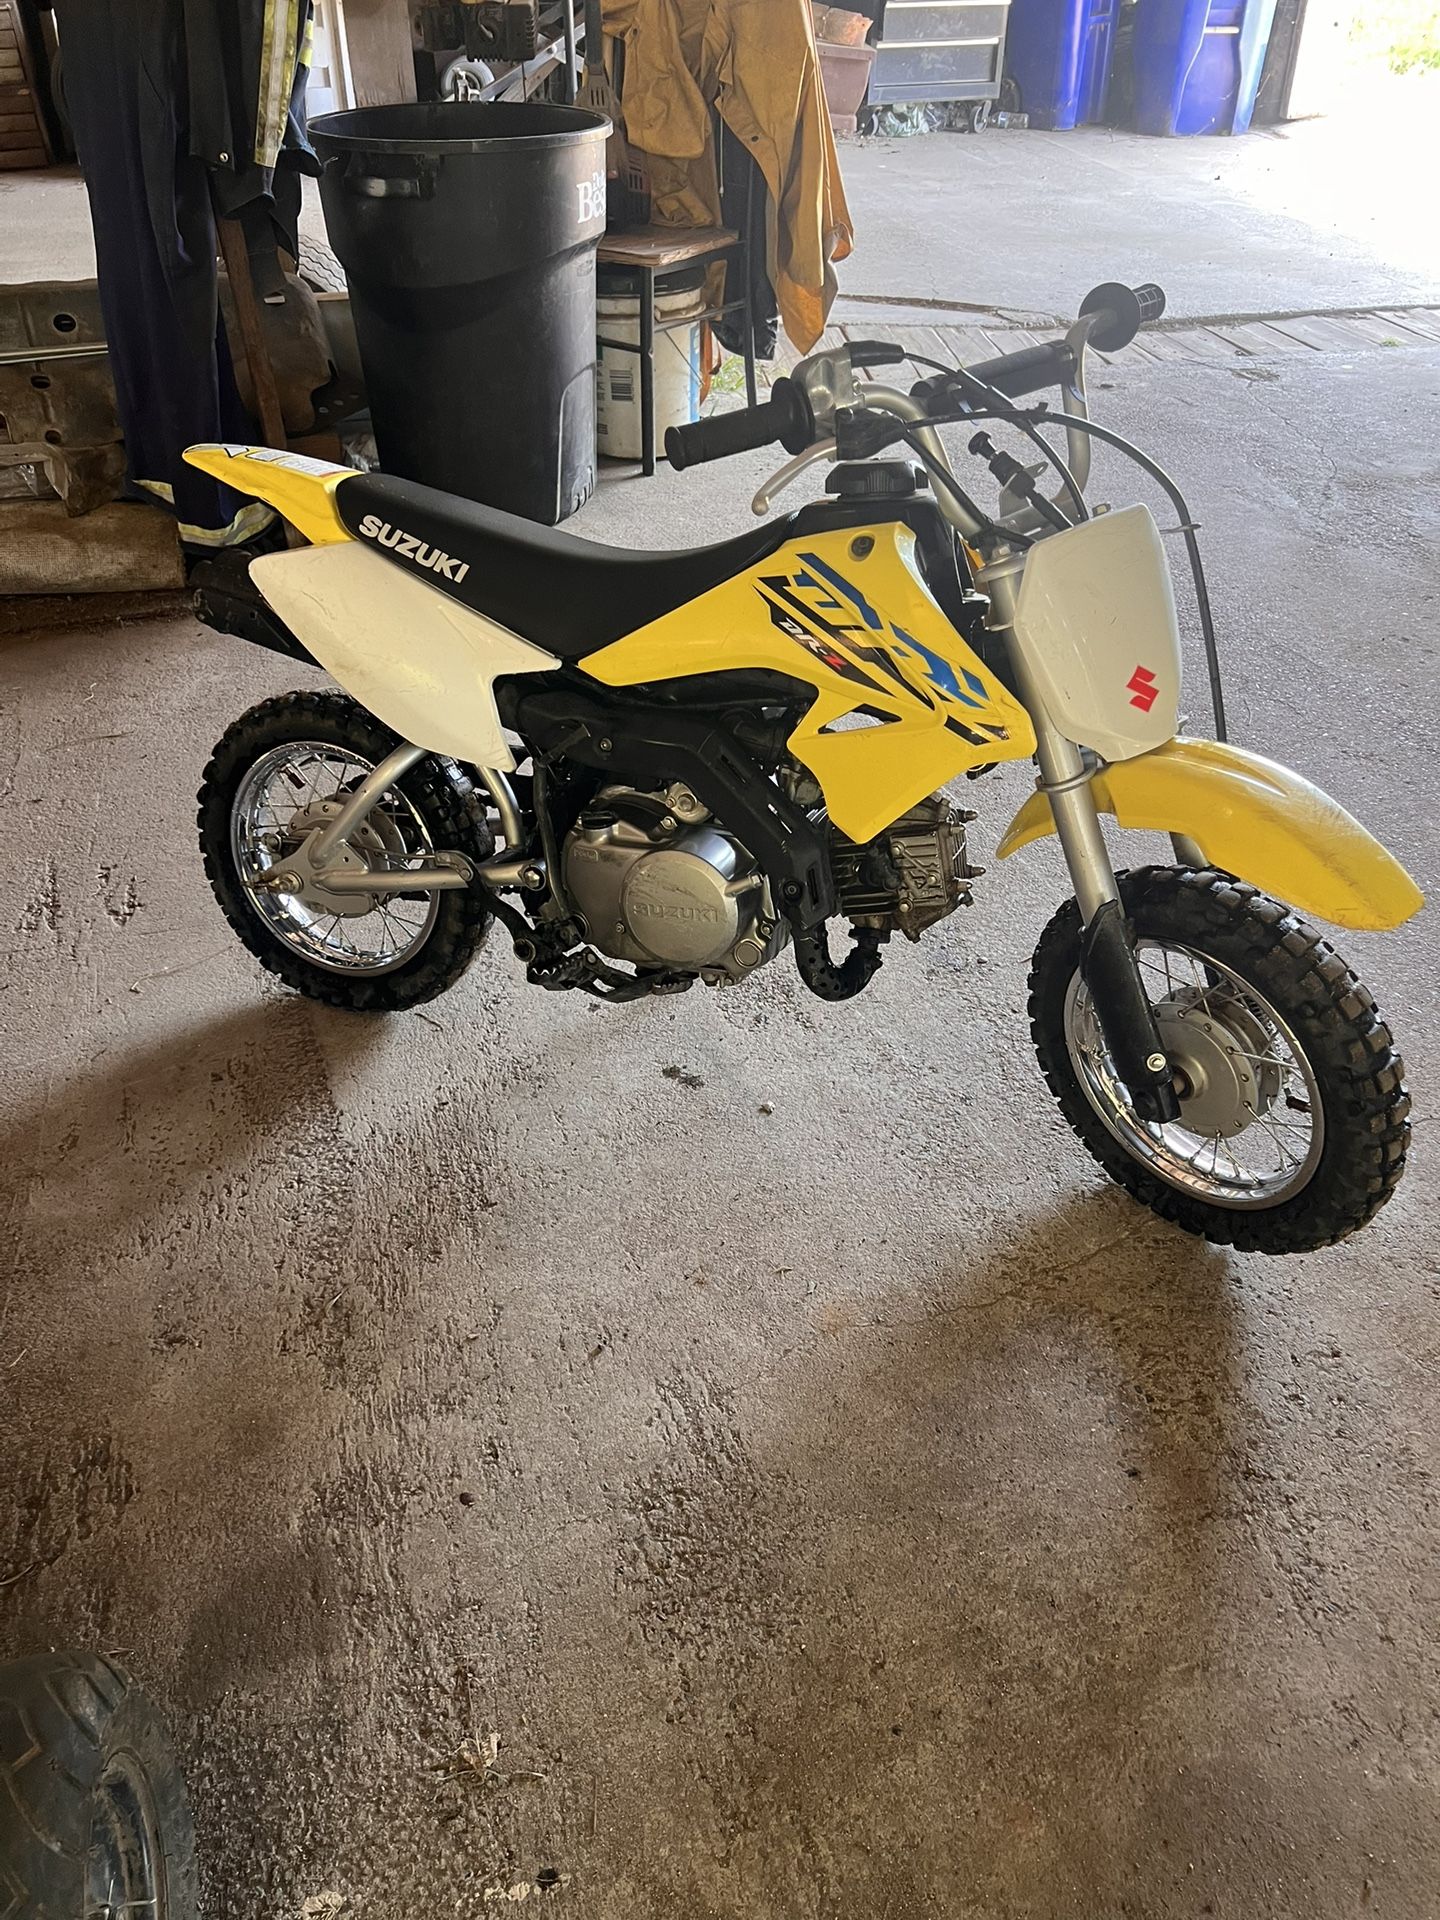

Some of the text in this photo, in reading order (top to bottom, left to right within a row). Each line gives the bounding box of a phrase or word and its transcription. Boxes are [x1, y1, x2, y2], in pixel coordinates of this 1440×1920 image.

[358, 514, 470, 584] SUZUKI
[779, 617, 848, 671] DR-Z
[632, 903, 719, 923] SUZUKI
